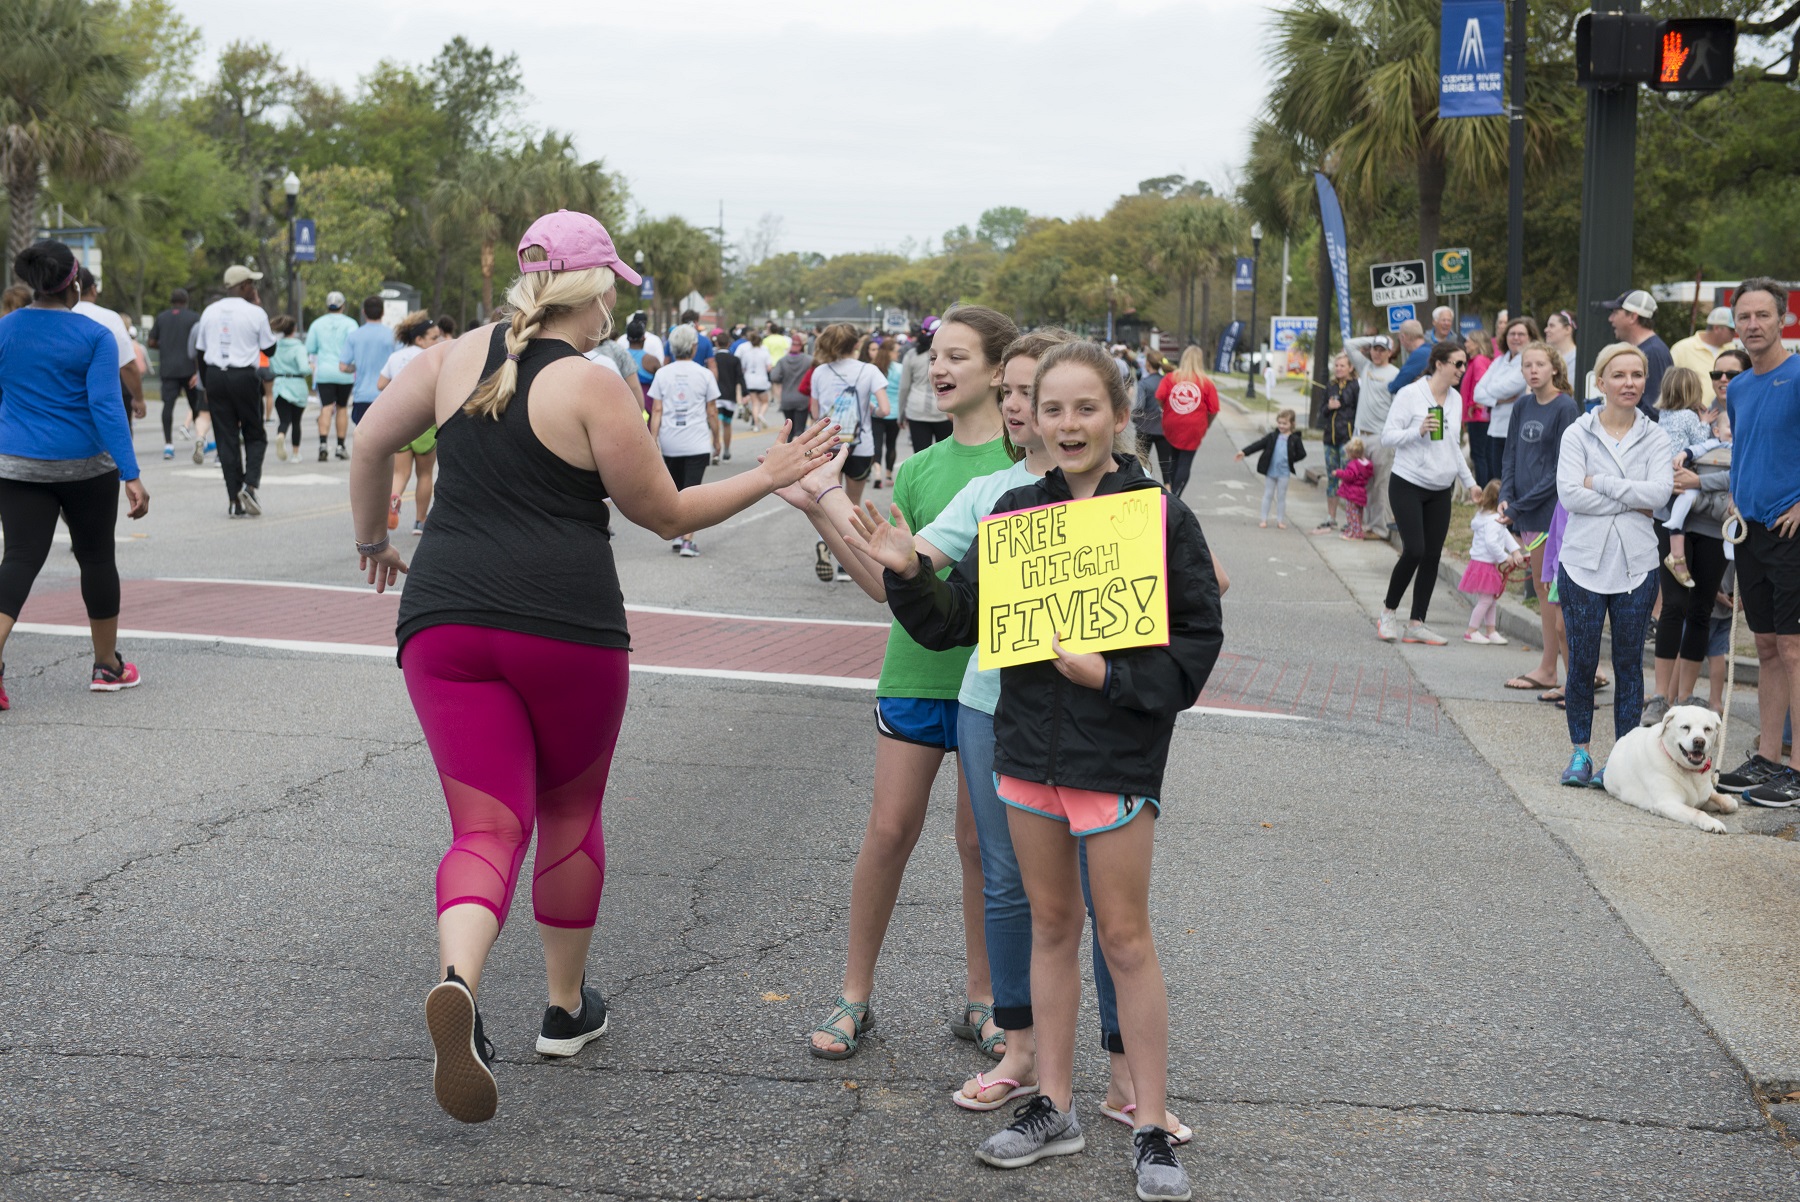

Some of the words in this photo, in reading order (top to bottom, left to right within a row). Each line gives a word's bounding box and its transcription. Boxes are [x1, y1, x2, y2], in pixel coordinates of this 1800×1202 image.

[1442, 74, 1474, 83] COOPER
[1476, 72, 1501, 81] RIVER
[1442, 82, 1475, 93] BRIDGE
[1478, 81, 1501, 91] RUN
[1375, 289, 1396, 301] BIKE
[1400, 287, 1425, 300] LANE
[987, 504, 1067, 564] FREE
[1021, 542, 1120, 589] HIGH
[990, 575, 1158, 653] FIVES!
